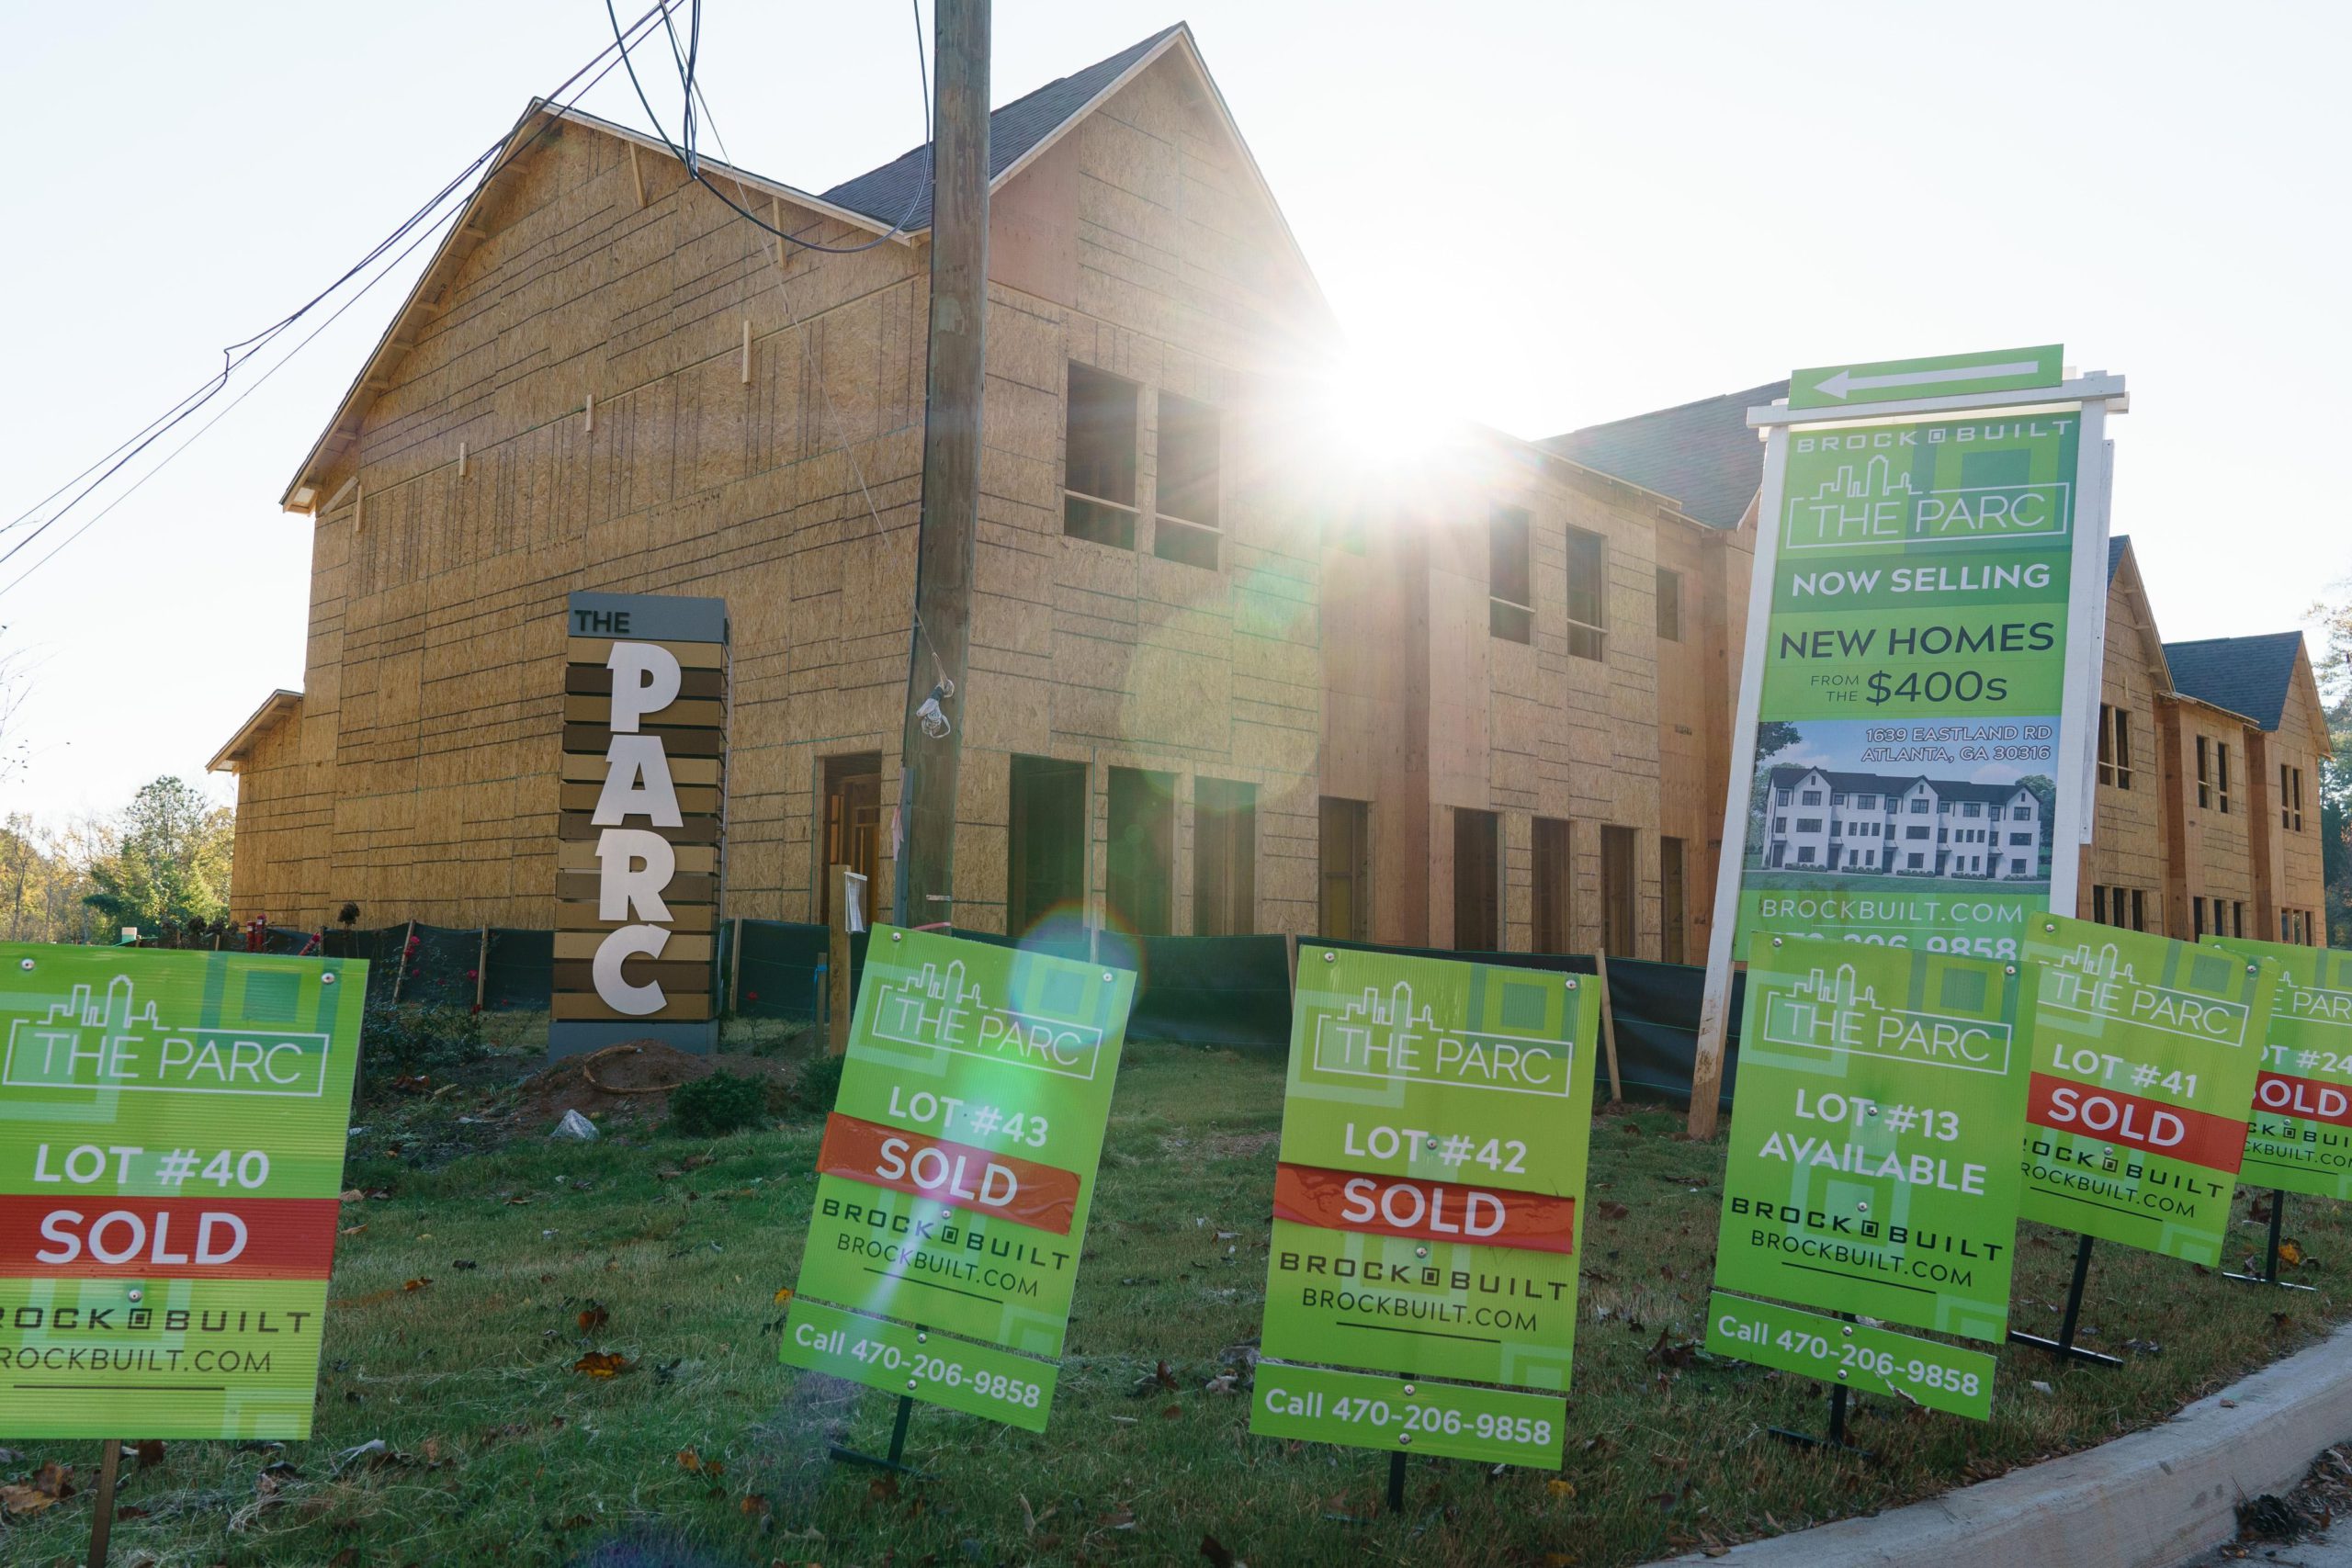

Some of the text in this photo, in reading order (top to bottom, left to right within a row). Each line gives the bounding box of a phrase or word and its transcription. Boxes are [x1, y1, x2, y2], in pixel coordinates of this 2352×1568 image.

[1797, 420, 2073, 454] BROCK BUILT
[1809, 492, 2045, 538] THE PARC
[1792, 563, 2050, 597] NOW SELLING
[574, 609, 630, 634] THE
[1780, 622, 2054, 660] NEW HOMES
[1811, 674, 1860, 686] FROM
[1826, 691, 1858, 702] THE
[1865, 670, 2007, 706] $400s
[1861, 745, 2052, 763] ATLANTA, GA 30316
[1866, 725, 2052, 743] 1639 EASTLAND RD
[591, 641, 684, 1016] PARC
[1762, 898, 2022, 923] BROCKBUILT.COM
[2051, 971, 2123, 1012] THE
[2131, 989, 2230, 1034] PARC
[2292, 991, 2352, 1020] PAR
[35, 1032, 302, 1083] THE PARC
[895, 997, 1081, 1066] THE PARC
[1336, 1026, 1551, 1084] THE PARC
[1783, 1002, 1991, 1063] THE PARC
[2052, 1043, 2197, 1099] LOT #41
[2296, 1049, 2352, 1075] #24
[888, 1086, 1049, 1147] LOT #43
[1795, 1089, 1959, 1142] LOT #13
[2047, 1088, 2185, 1146] SOLD
[2252, 1079, 2347, 1117] OLD
[34, 1144, 269, 1189] LOT #40
[875, 1137, 1018, 1208] SOLD
[1344, 1122, 1526, 1174] LOT #42
[1758, 1131, 1986, 1196] AVAILABLE
[2023, 1138, 2224, 1198] OCK BUILT
[2244, 1140, 2352, 1168] KBUILT.CO
[1341, 1178, 1506, 1236] SOLD
[1732, 1197, 2003, 1261] BROCK BUILT
[35, 1210, 248, 1265] SOLD
[821, 1198, 1069, 1270] BROCK BUILT
[1751, 1229, 1971, 1287] BROCKBUILT.COM
[837, 1234, 1037, 1297] BROCKBUILT.COM
[1280, 1252, 1567, 1301] BROCK BUILT
[0, 1307, 311, 1333] OCK BUILT
[1302, 1288, 1537, 1333] BROCKBUILT.COM
[795, 1323, 1041, 1408] Call 470-206-9858
[1717, 1314, 1979, 1397] Call 470-206-9858
[1265, 1388, 1551, 1447] Call 470-206-9858
